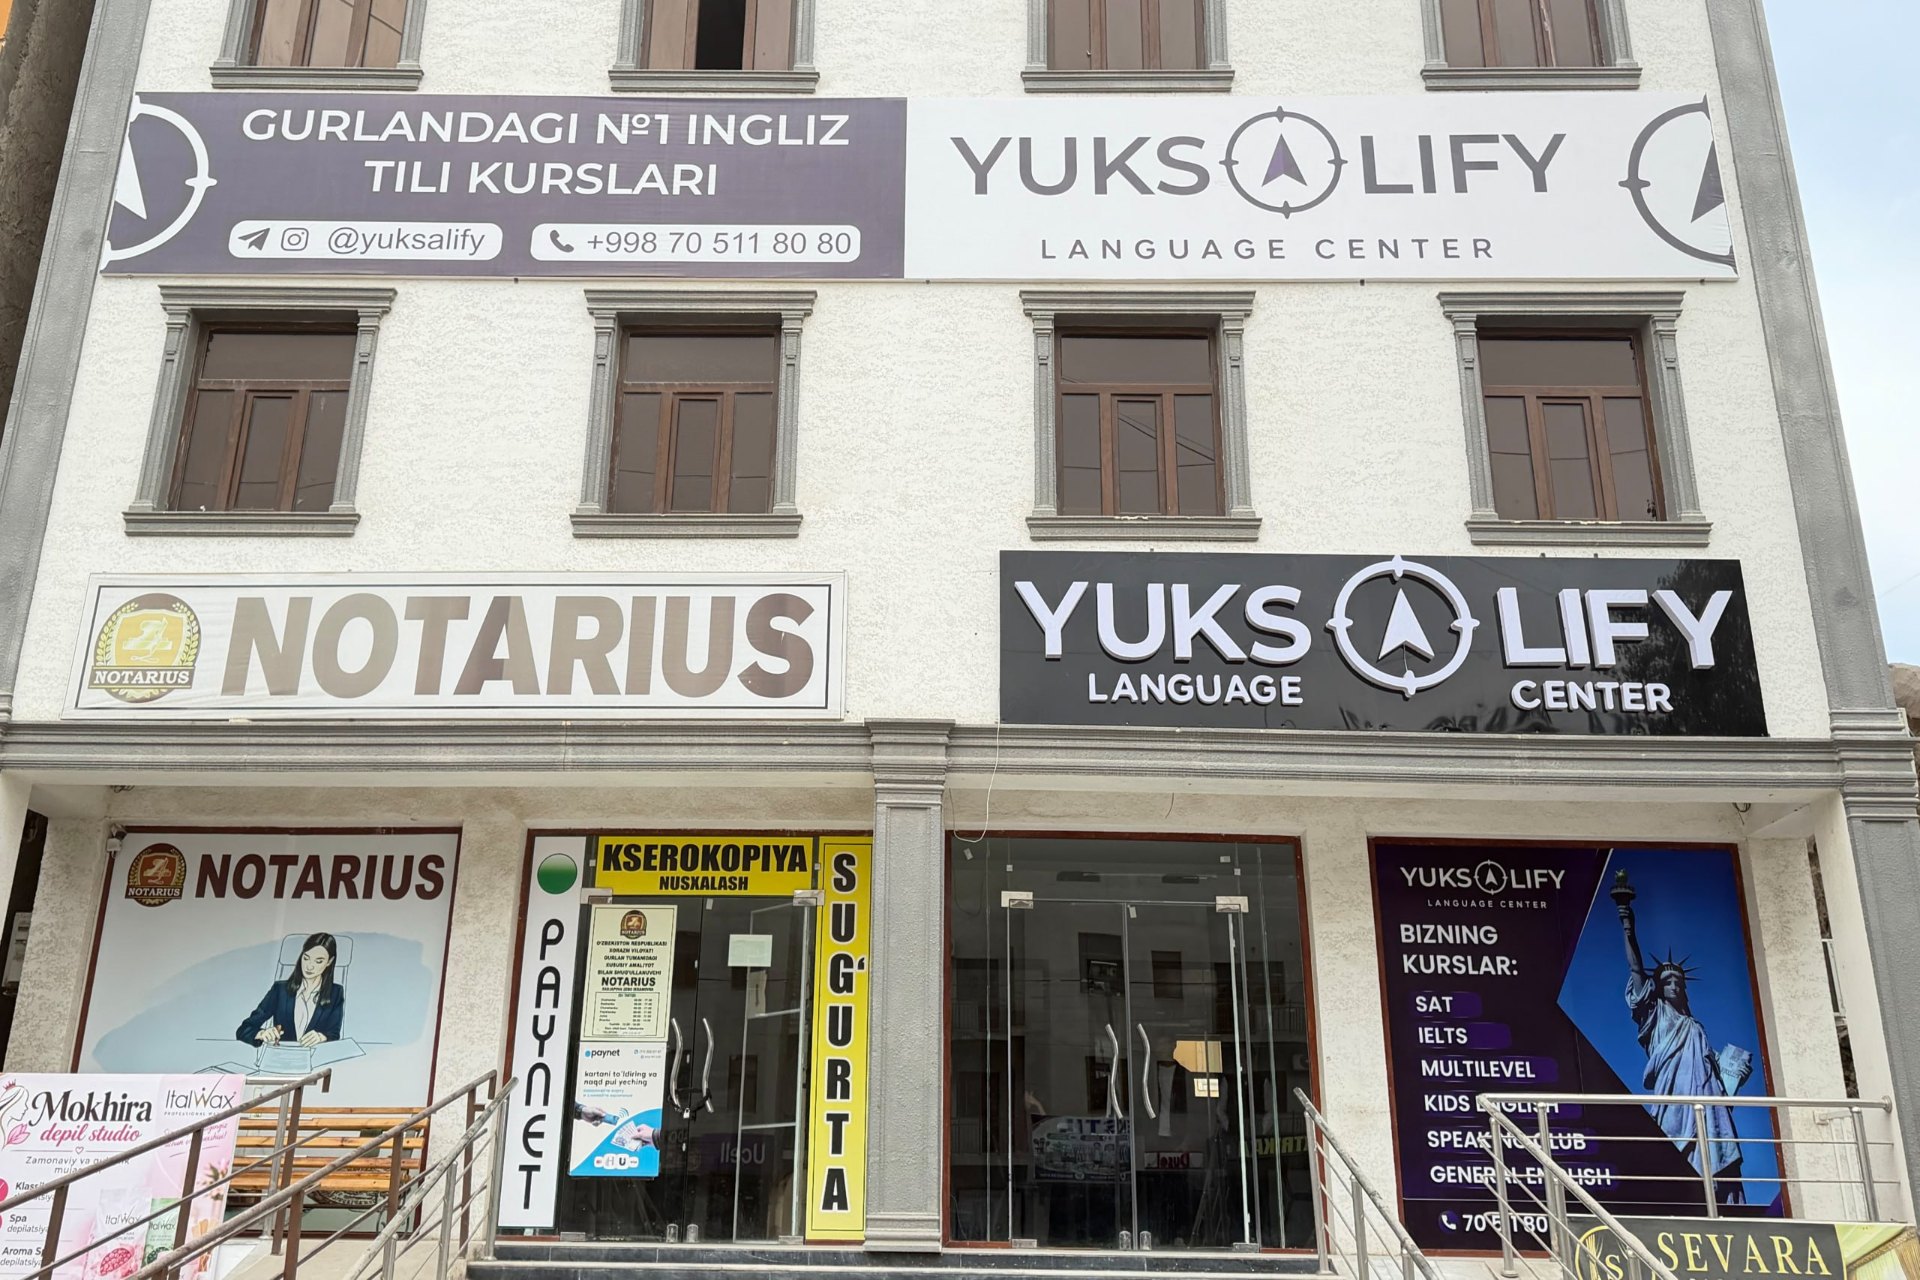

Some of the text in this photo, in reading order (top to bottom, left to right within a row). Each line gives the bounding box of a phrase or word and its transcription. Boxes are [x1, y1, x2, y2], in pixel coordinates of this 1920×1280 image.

[242, 109, 578, 144] GURLANDAGI
[687, 113, 850, 146] INGLIZ
[364, 160, 718, 196] TILI KURSLARI
[328, 227, 486, 256] @yuksalify
[587, 231, 852, 255] +998 70 511 80 80
[1040, 238, 1494, 261] LANGUAGE CENTER
[220, 592, 816, 699] NOTARIUS
[93, 669, 190, 684] NOTARIUS
[1088, 673, 1675, 714] LANGUAGE CENTER
[602, 843, 808, 873] KSEROKOPIYA
[194, 853, 446, 900] NOTARIUS
[658, 875, 749, 891] NUSXALASH
[127, 887, 181, 898] NOTARIUS
[1427, 899, 1548, 910] LANGUAGE CENTER
[1400, 924, 1498, 945] BIZNING
[1402, 954, 1519, 976] KURSLAR:
[601, 977, 656, 987] NOTARIUS
[1415, 996, 1454, 1013] SAT
[1418, 1027, 1468, 1044] IELTS
[590, 1049, 621, 1059] paynet
[1421, 1060, 1536, 1078] MULTILEVEL
[583, 1079, 648, 1087] naqd pul yeching
[28, 1089, 153, 1127] Mokhira
[1424, 1095, 1471, 1112] KIDS
[40, 1122, 143, 1147] depil studio
[25, 1156, 77, 1168] Zamonaviy
[9, 1213, 27, 1224] Spa
[2, 1246, 33, 1256] Aroma
[1656, 1231, 1832, 1276] SEVARA
